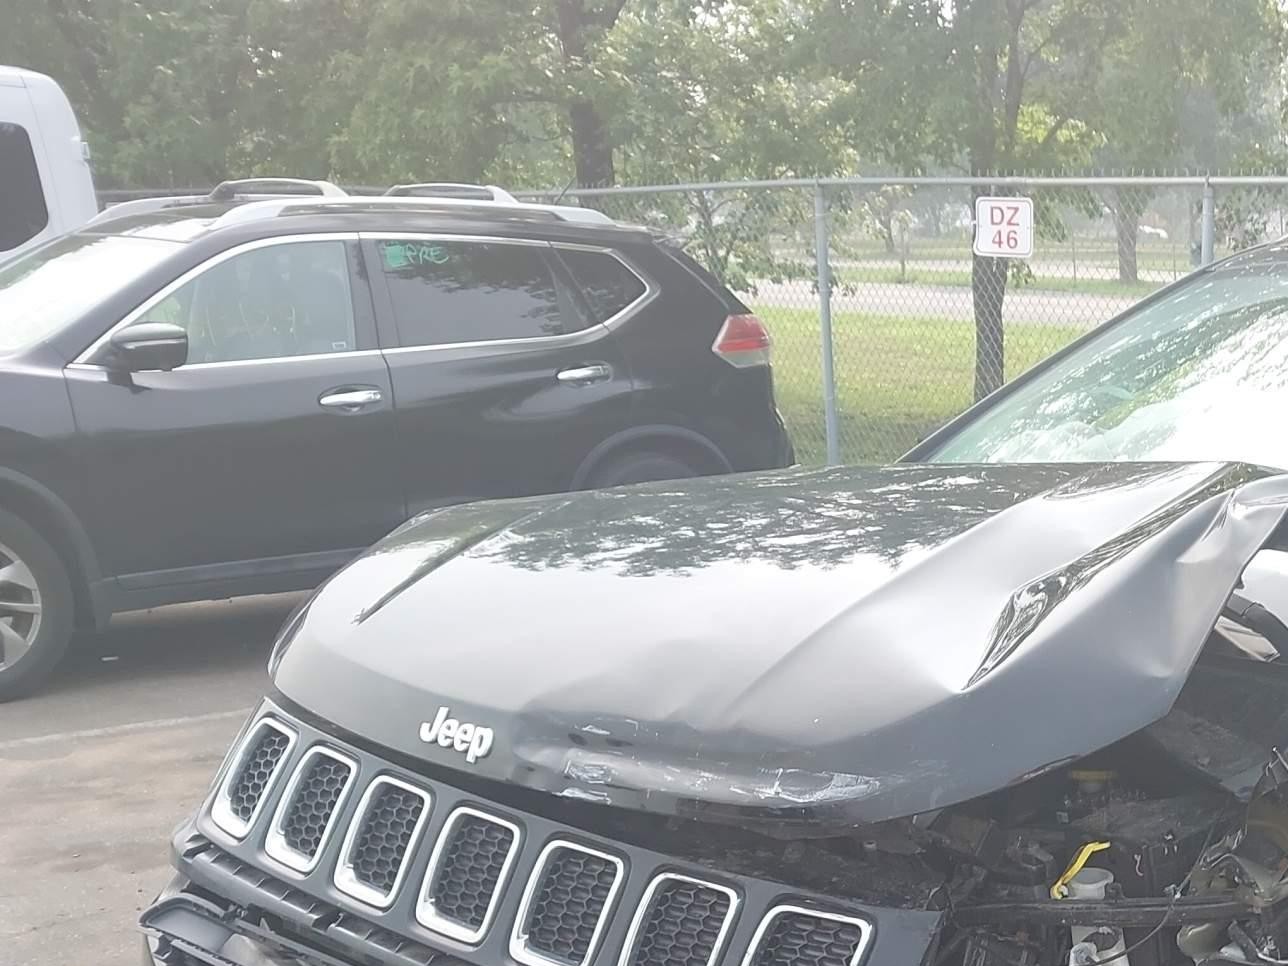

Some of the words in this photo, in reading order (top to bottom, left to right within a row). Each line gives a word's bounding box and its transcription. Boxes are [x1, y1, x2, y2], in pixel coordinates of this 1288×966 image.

[990, 206, 1020, 226] DZ
[992, 230, 1018, 249] 46
[420, 706, 494, 764] Jeep
